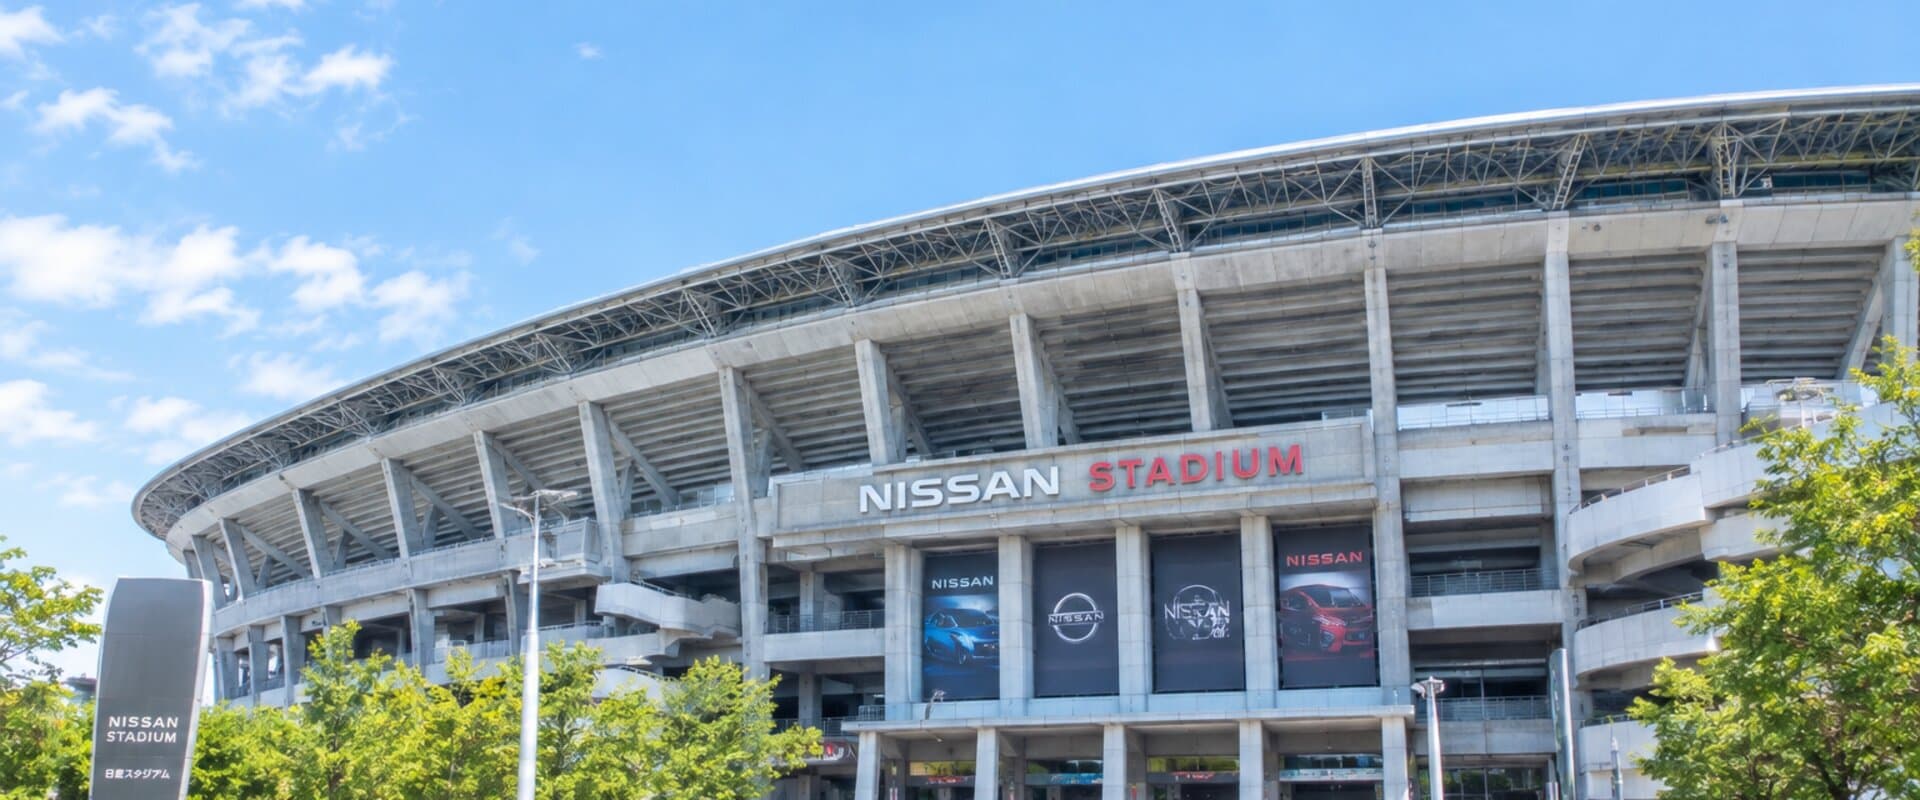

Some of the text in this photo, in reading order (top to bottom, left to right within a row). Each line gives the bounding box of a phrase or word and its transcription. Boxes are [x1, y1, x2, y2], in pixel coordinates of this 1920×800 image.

[859, 444, 1304, 513] NISSAN STADIUM
[1286, 551, 1362, 567] NISSAN
[931, 575, 994, 590] NISSAN
[1049, 611, 1104, 625] NISSAN
[109, 716, 178, 728] NISSAN
[106, 730, 177, 743] STADIUM
